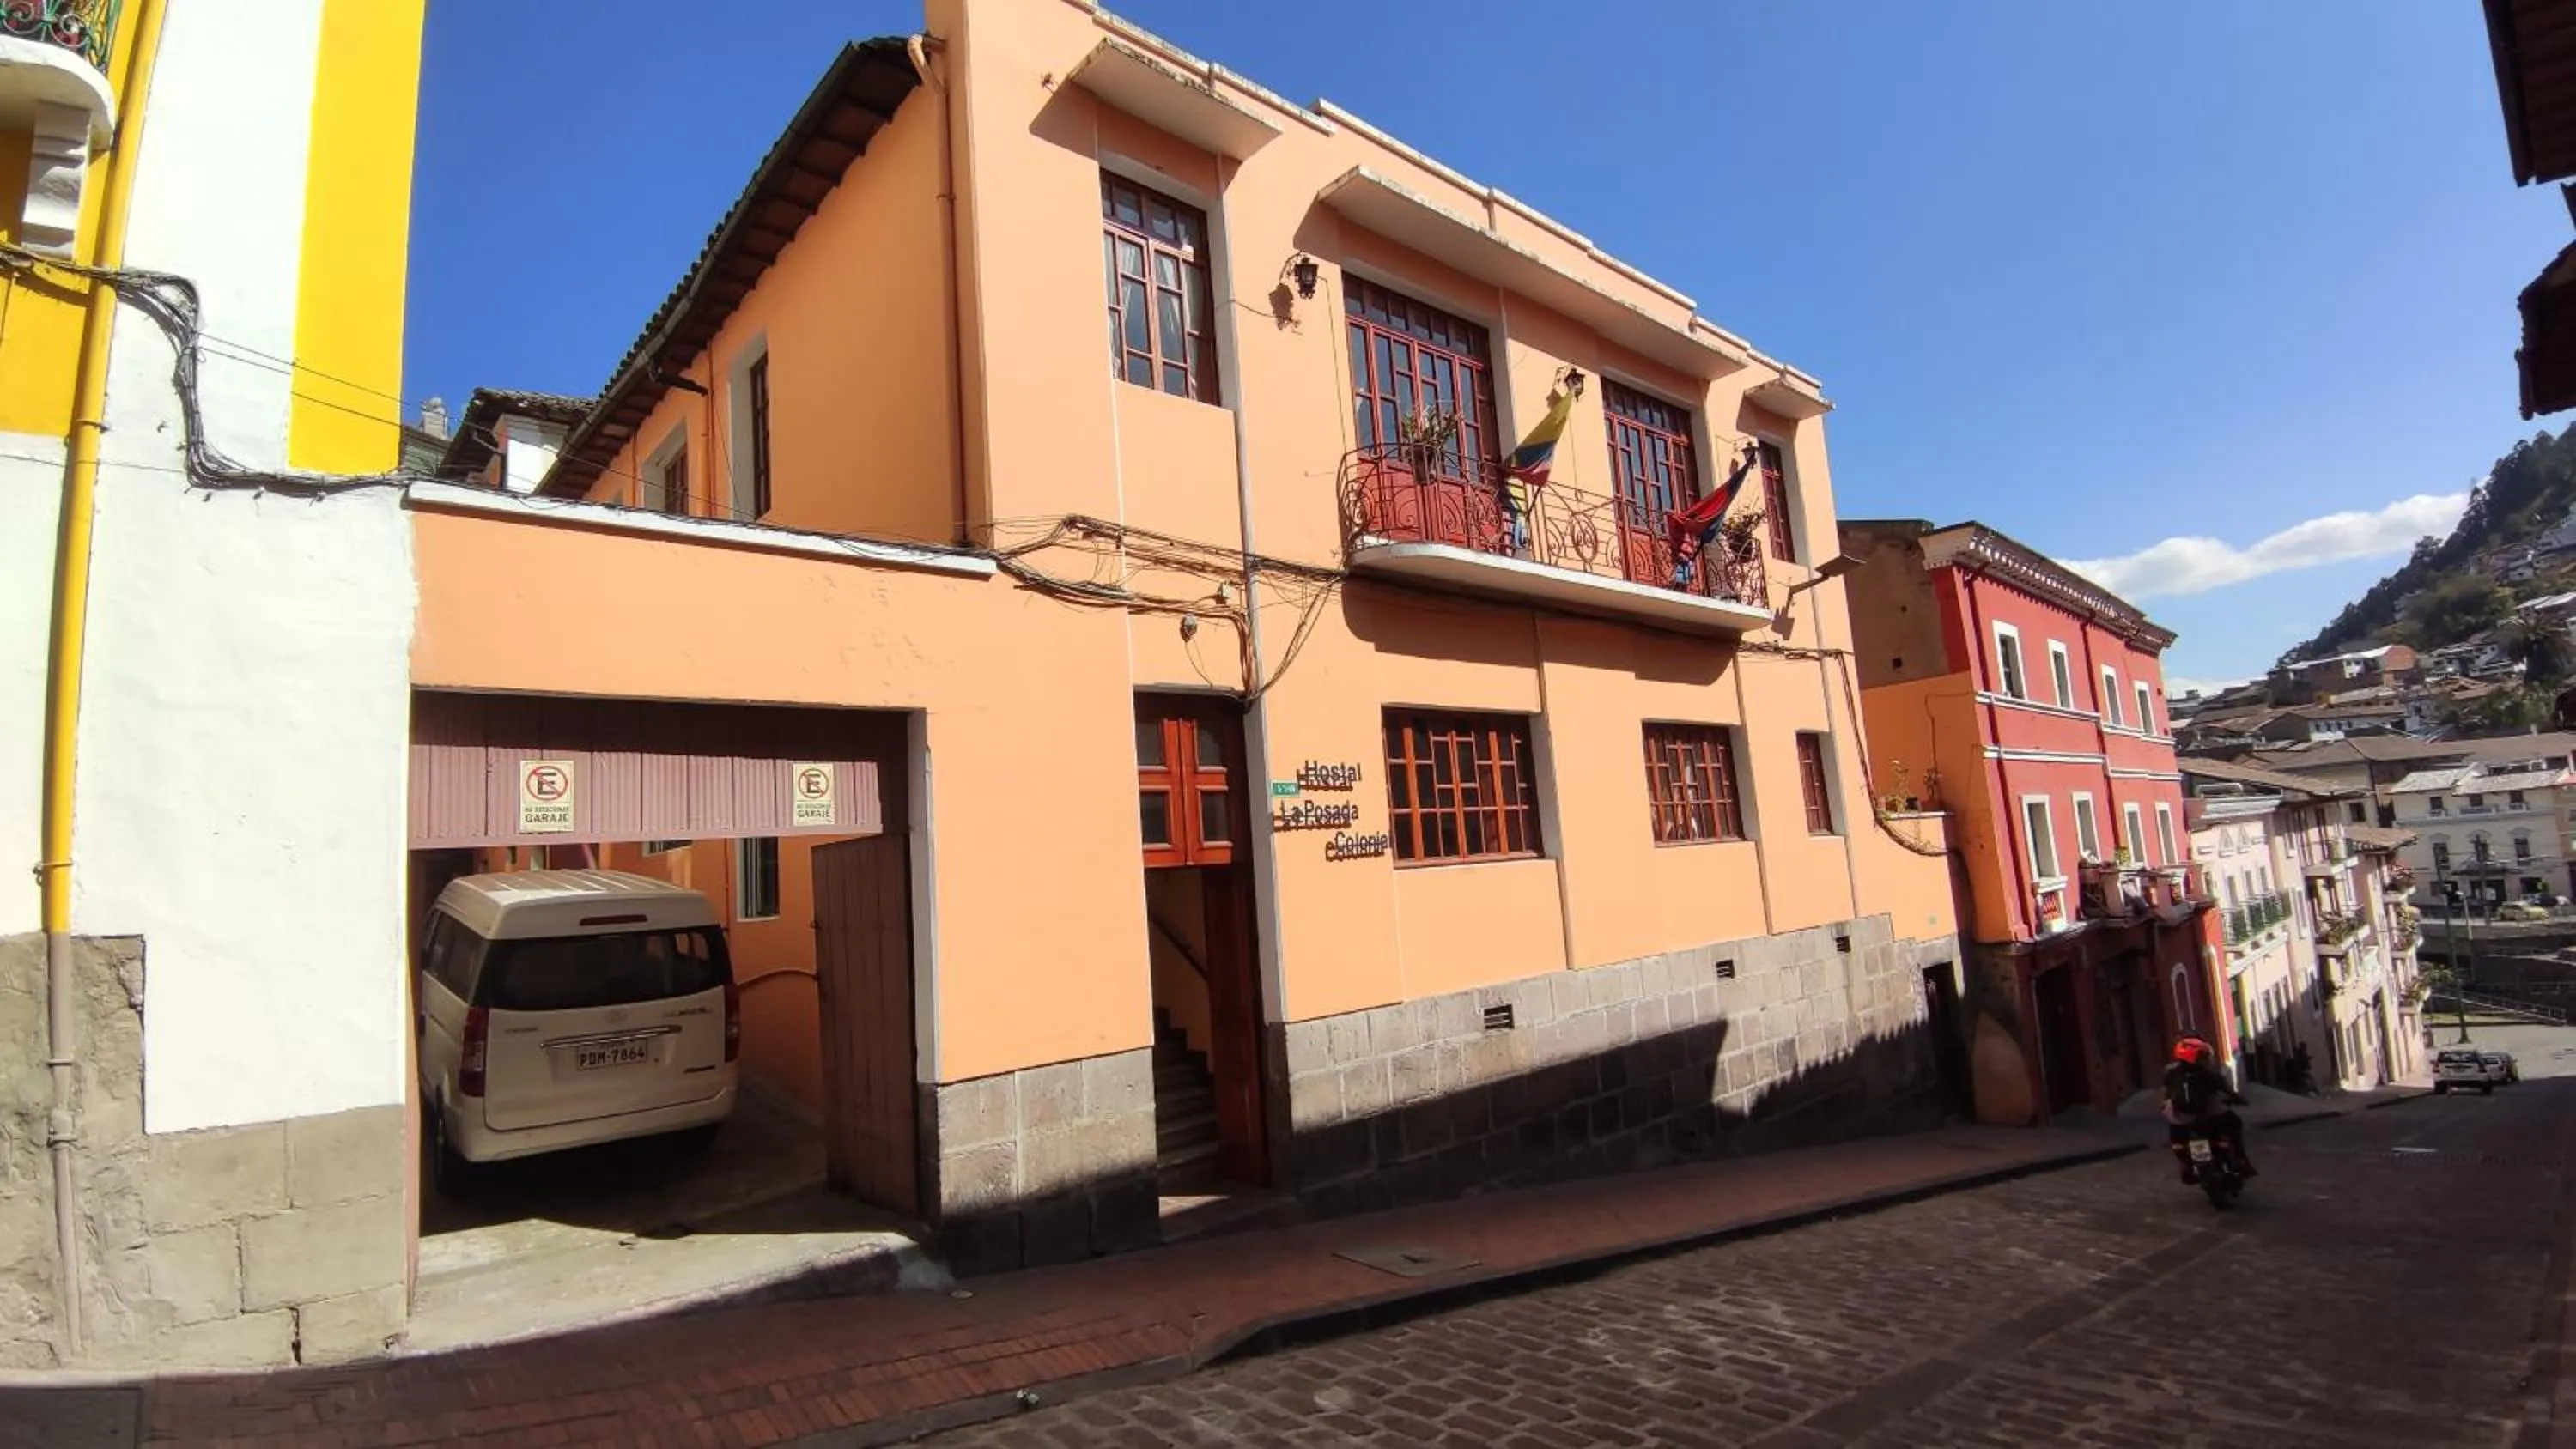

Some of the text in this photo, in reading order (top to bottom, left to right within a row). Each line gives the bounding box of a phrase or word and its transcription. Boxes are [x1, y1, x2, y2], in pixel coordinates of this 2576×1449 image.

[1304, 760, 1362, 782] Hostal
[525, 813, 569, 823] GARAJE
[1279, 799, 1358, 823] La Posada
